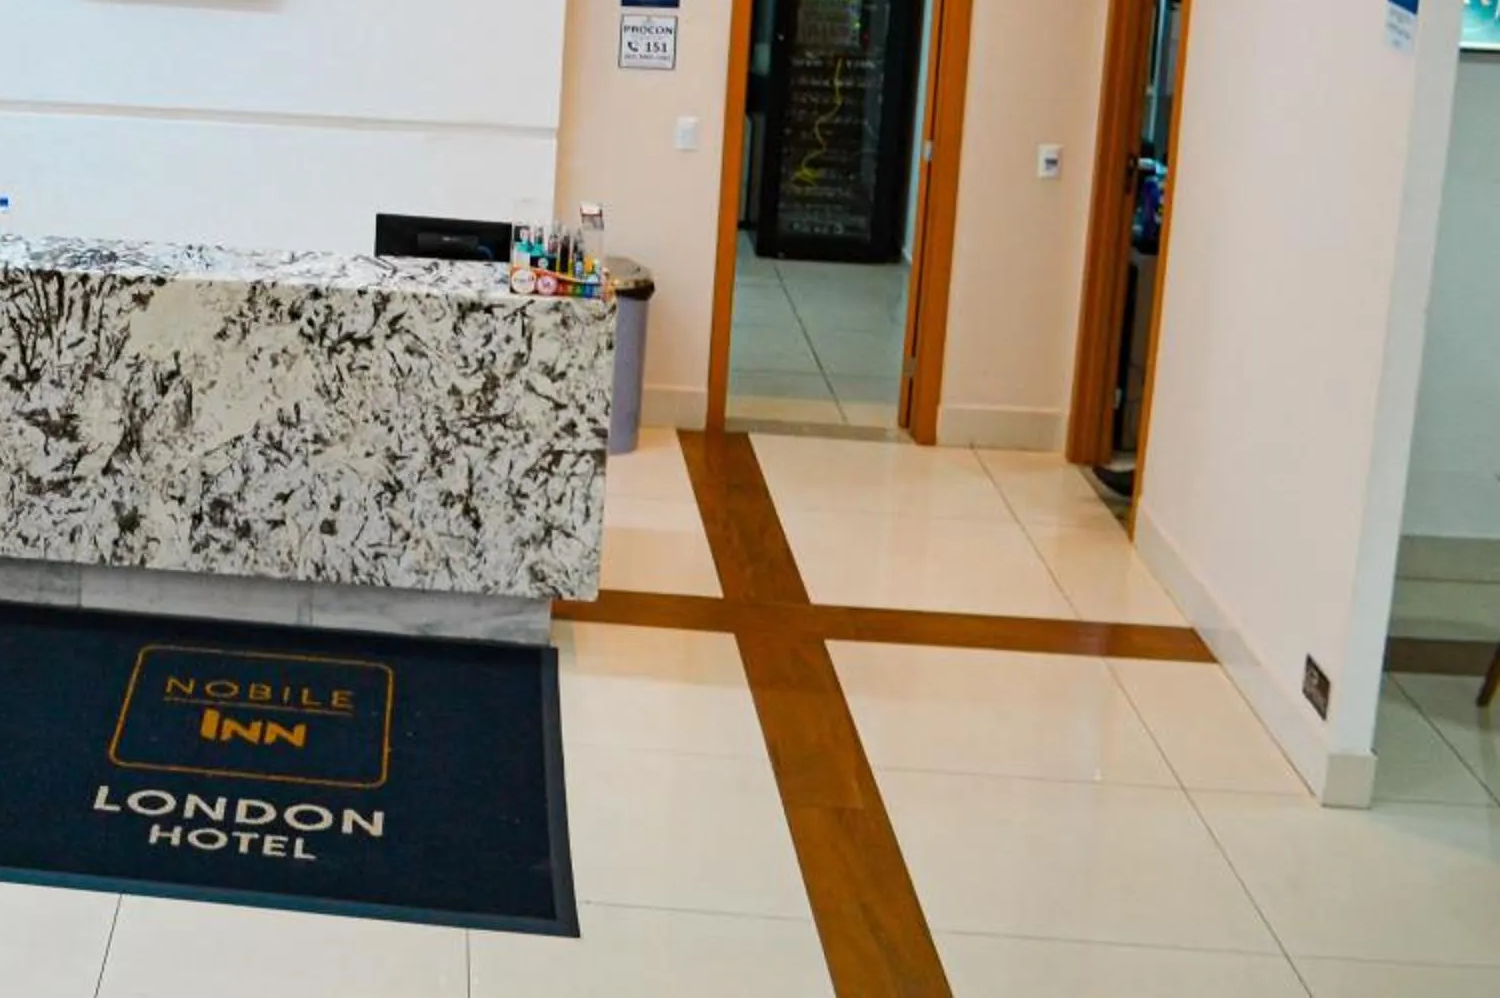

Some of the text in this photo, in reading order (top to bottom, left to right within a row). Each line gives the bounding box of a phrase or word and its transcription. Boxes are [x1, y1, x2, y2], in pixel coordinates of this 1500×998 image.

[645, 41, 668, 53] 151
[165, 676, 355, 708] NOBILE
[200, 708, 307, 748] INN
[93, 785, 384, 837] LONDON
[149, 824, 317, 860] HOTEL
